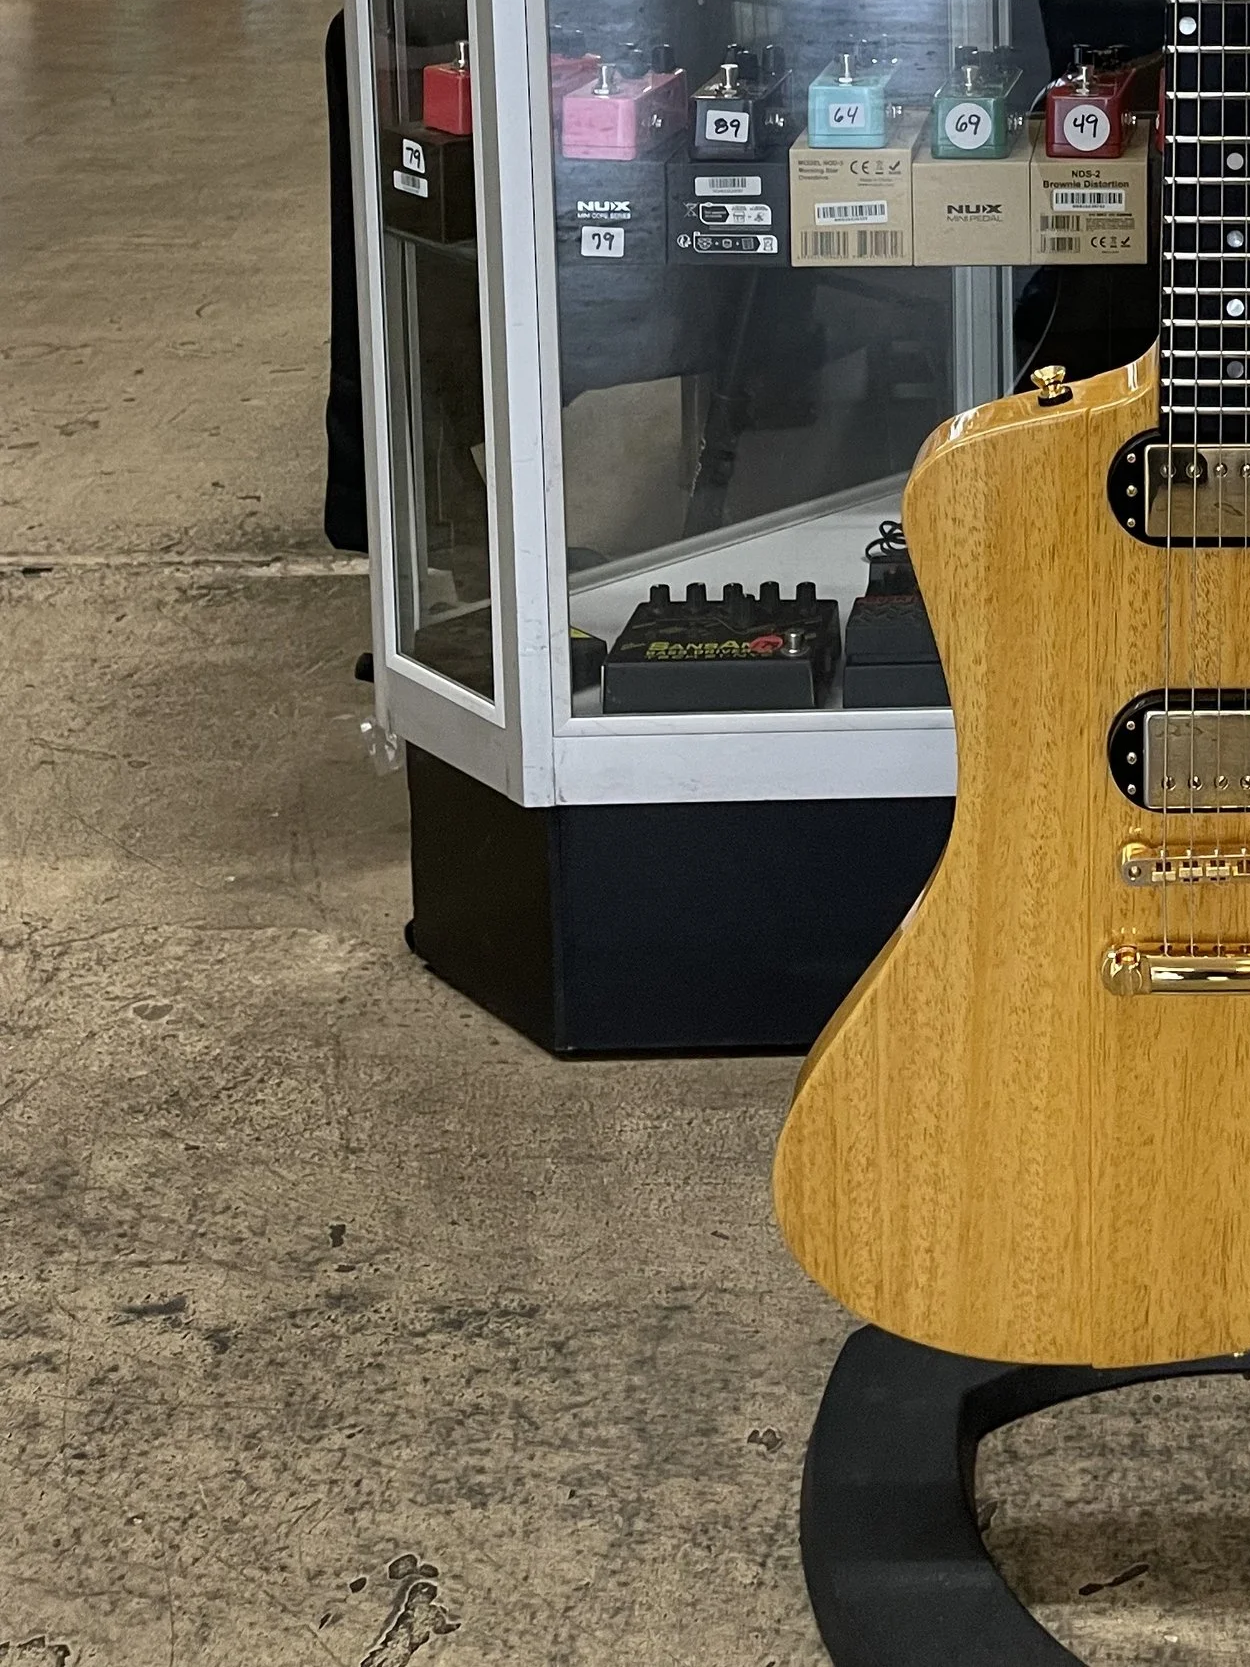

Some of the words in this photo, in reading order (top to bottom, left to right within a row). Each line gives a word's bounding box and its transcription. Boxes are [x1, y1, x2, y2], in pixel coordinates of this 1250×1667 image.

[834, 106, 859, 124] 64
[955, 113, 982, 136] 69
[713, 117, 741, 138] 89
[1072, 113, 1099, 139] 49
[405, 146, 421, 169] 79
[1043, 180, 1081, 189] Brownie
[1084, 180, 1130, 189] Distortion
[1071, 169, 1102, 179] NDS-2
[946, 203, 1003, 215] NUX
[591, 231, 615, 252] 79
